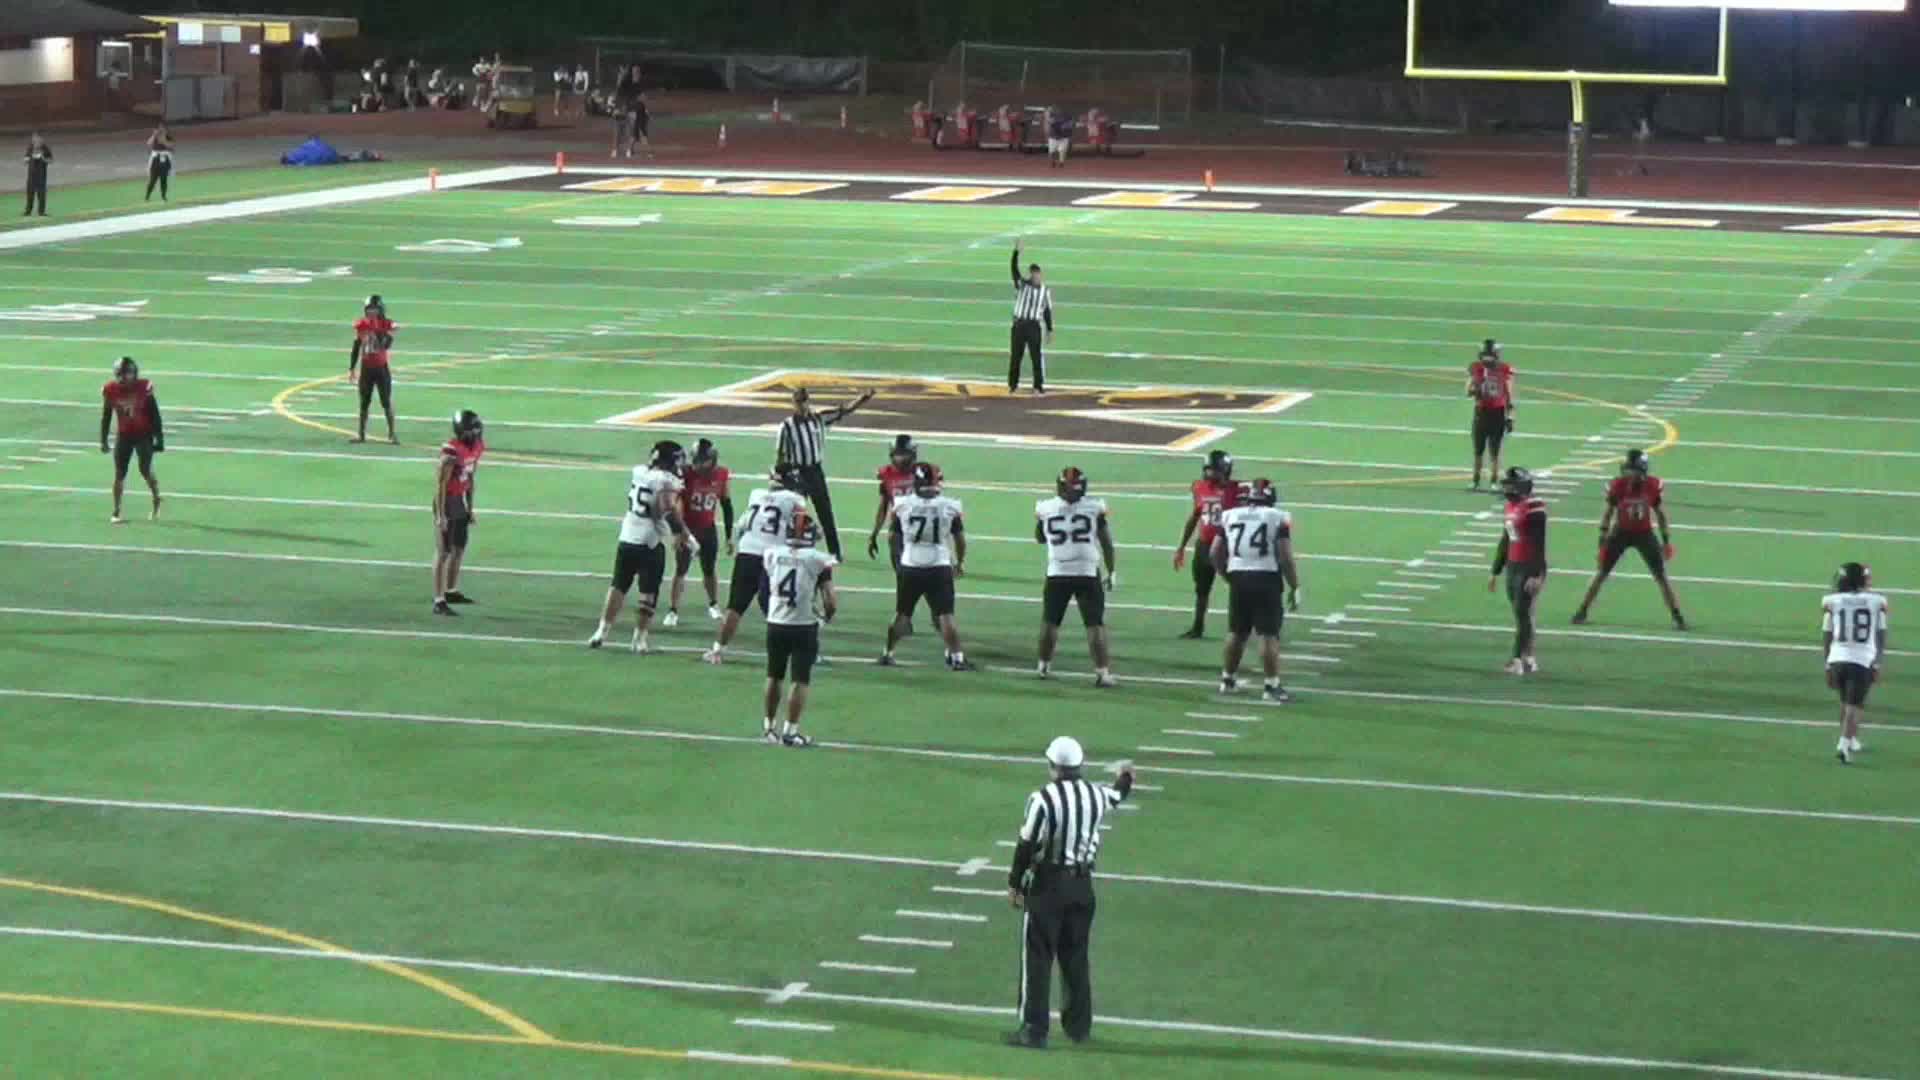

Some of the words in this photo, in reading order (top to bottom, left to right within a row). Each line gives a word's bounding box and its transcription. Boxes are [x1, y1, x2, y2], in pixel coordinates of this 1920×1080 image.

[745, 504, 782, 534] 73
[908, 516, 941, 545] 71
[1047, 515, 1092, 546] 52
[1228, 523, 1269, 558] 74
[777, 568, 798, 608] 4
[1838, 607, 1871, 643] 18
